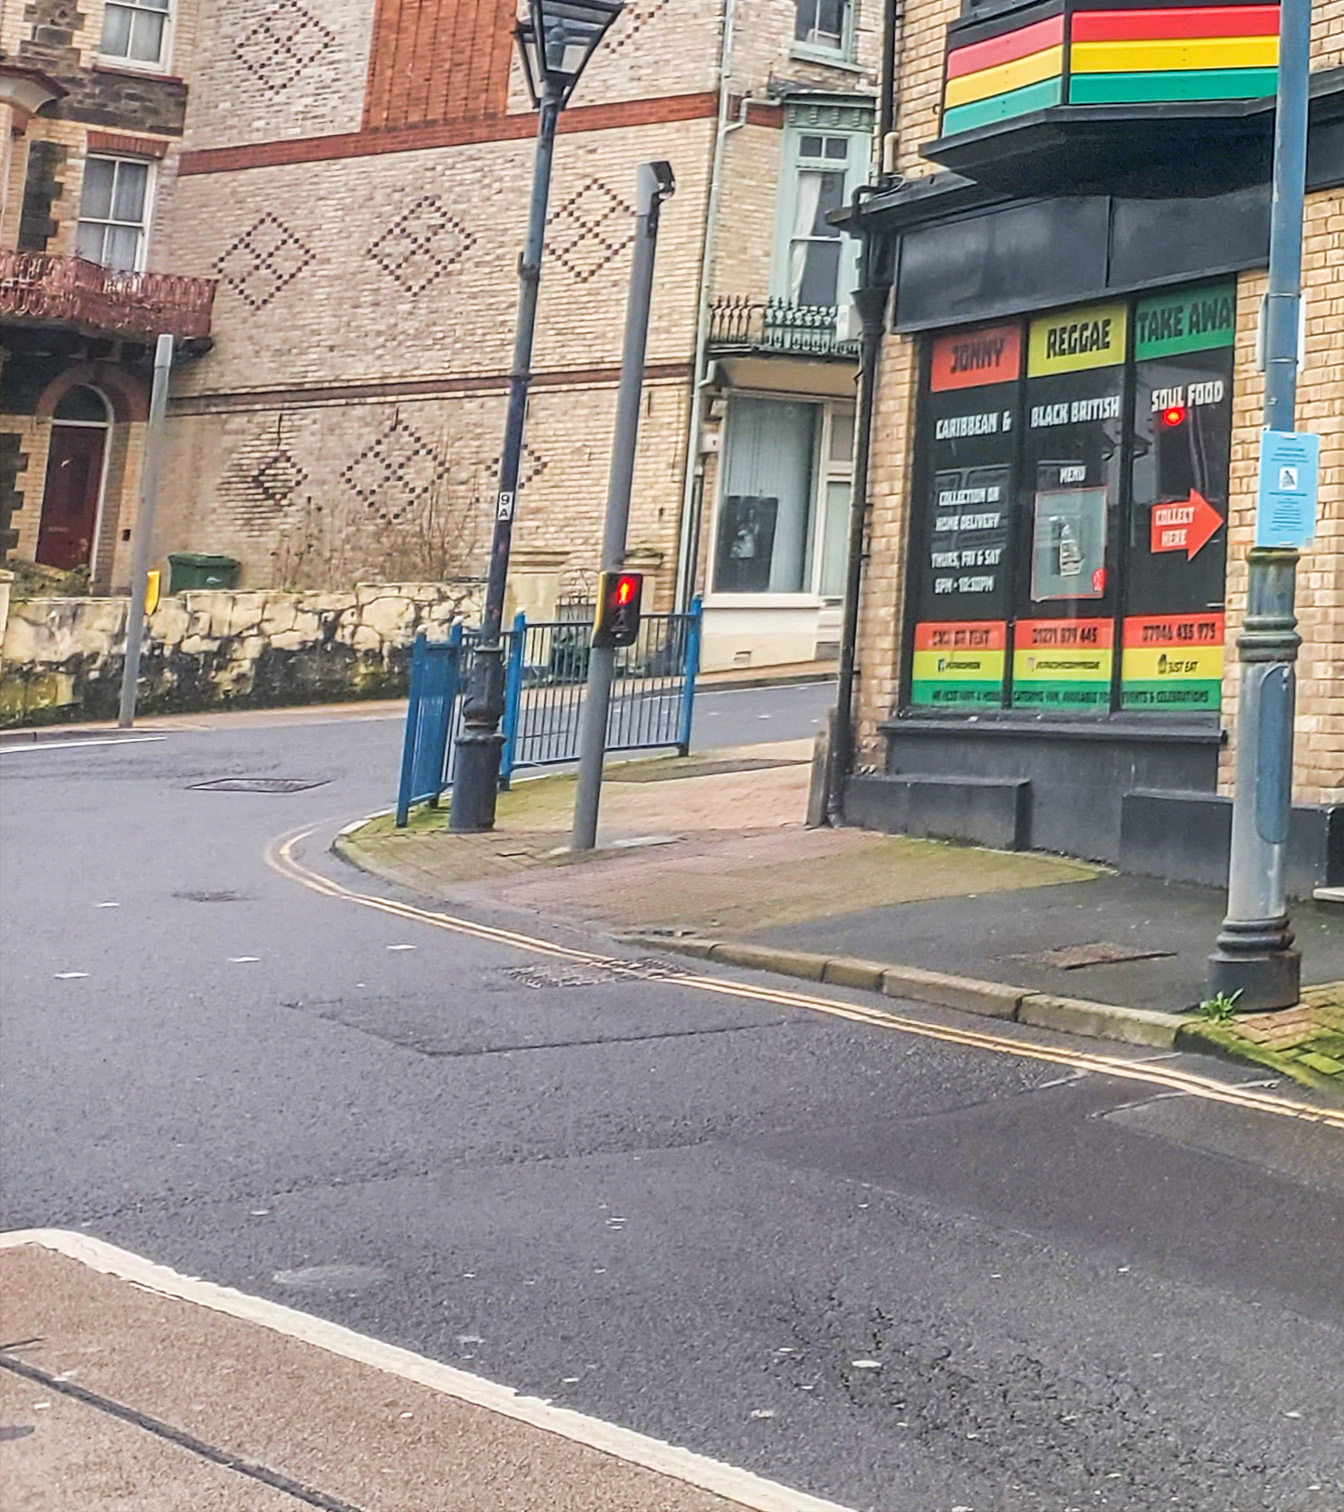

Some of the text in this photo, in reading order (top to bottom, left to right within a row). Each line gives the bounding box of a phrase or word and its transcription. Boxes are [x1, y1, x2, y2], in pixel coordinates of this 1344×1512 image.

[950, 296, 1234, 374] JONNY REGGAE TAKE AWA
[935, 379, 1224, 440] CARIBBEAN & BLACK BRITISH SOUL FOOD
[1060, 465, 1086, 484] MENU
[501, 494, 510, 505] 9
[939, 487, 987, 507] COLLECTION
[499, 508, 508, 518] A
[960, 512, 1001, 530] DELIVERY
[1155, 506, 1195, 526] COLLECT
[1161, 529, 1188, 548] HERE
[984, 548, 1002, 566] SAT
